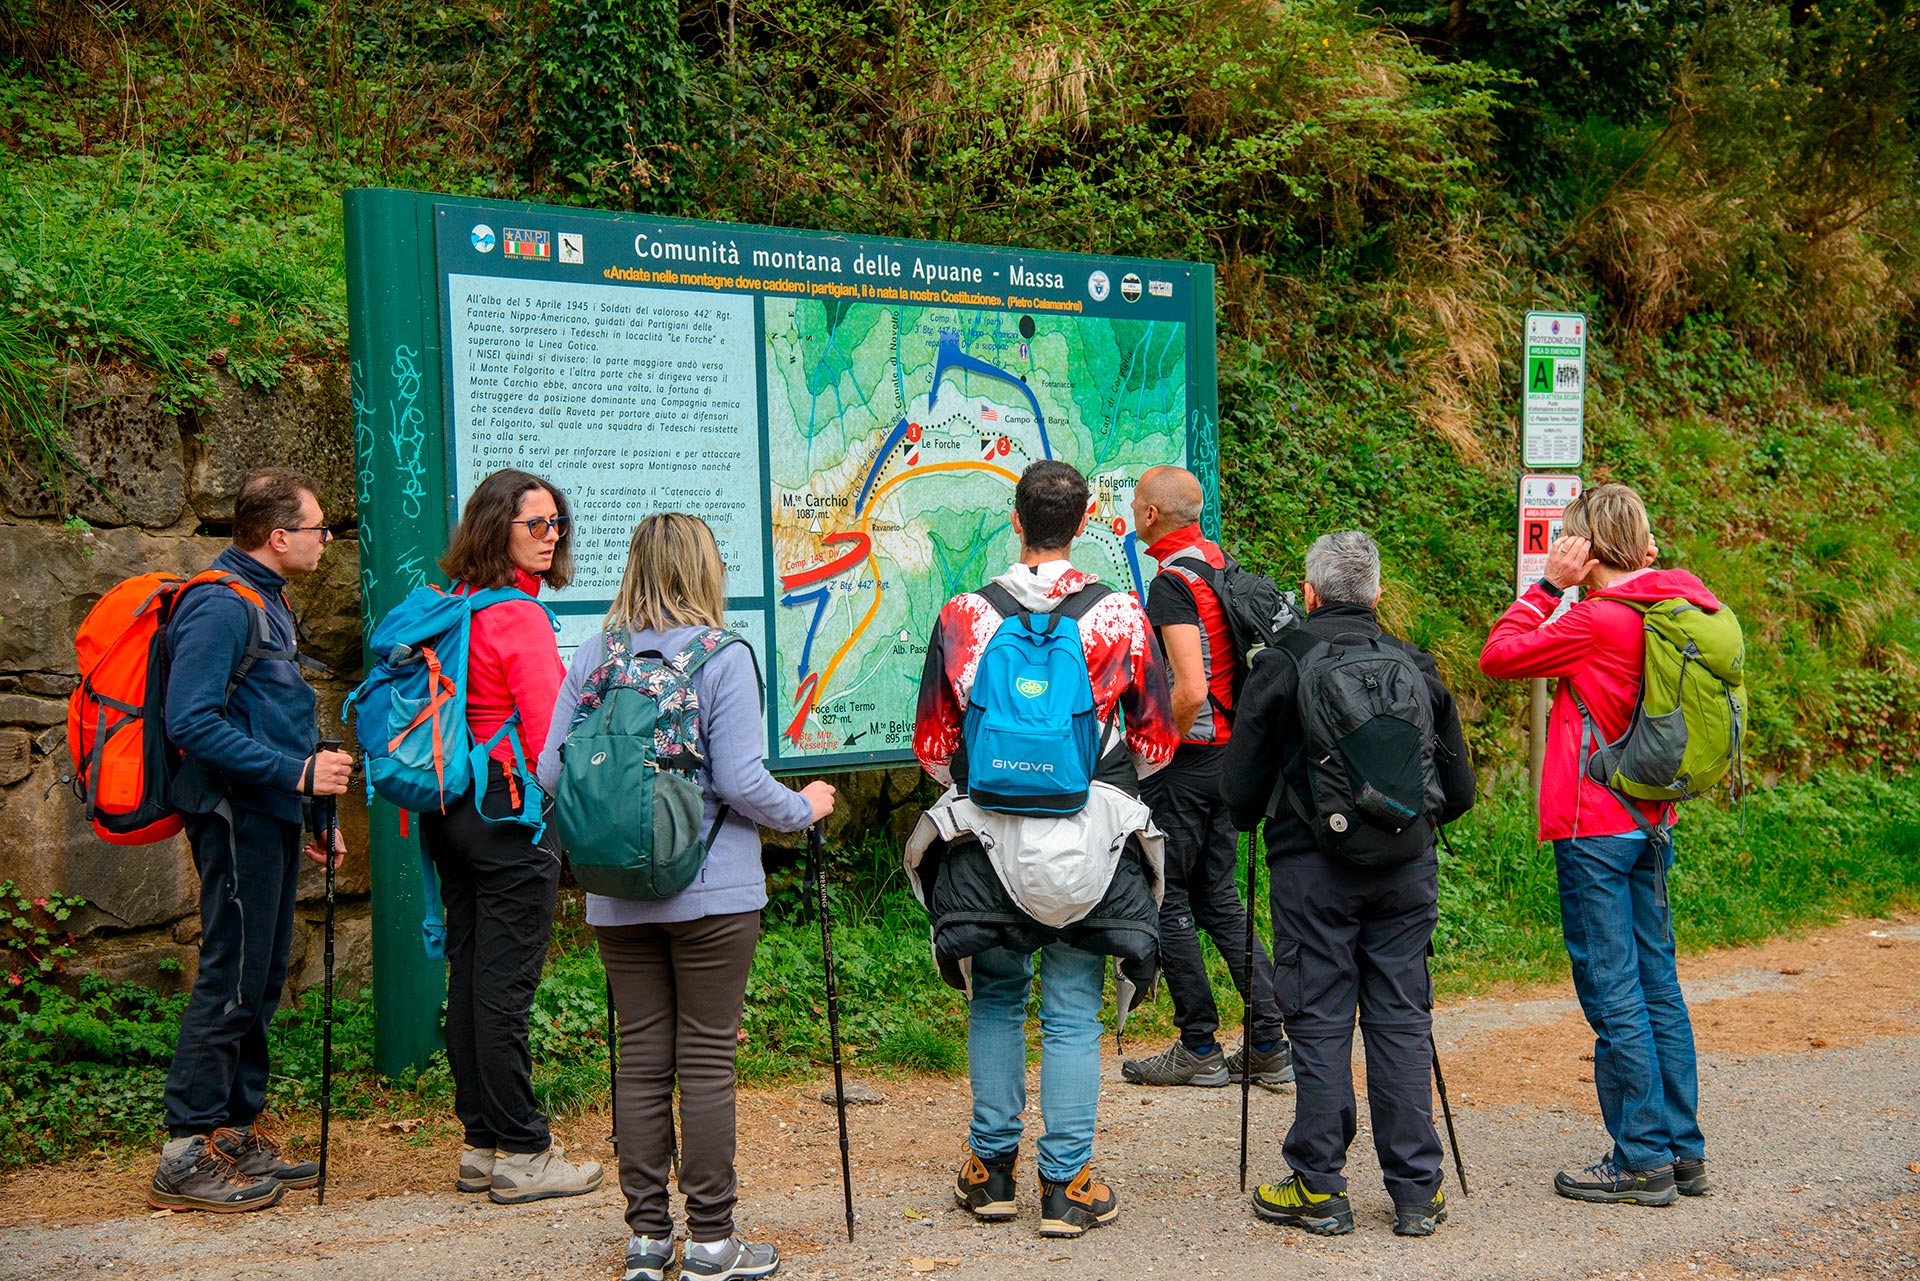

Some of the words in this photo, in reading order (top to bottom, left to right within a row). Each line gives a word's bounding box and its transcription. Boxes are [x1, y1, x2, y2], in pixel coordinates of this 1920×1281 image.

[635, 233, 740, 265] Comunità
[753, 250, 842, 272] montana
[853, 253, 901, 277] delle
[912, 257, 982, 285] Apuane
[1010, 265, 1064, 289] Massa
[603, 265, 651, 282] «Andate
[652, 270, 679, 284] nelle
[680, 272, 734, 290] montagne
[735, 275, 761, 290] dove
[762, 277, 805, 293] caddero
[806, 280, 810, 293] i
[811, 283, 860, 298] partigiani,
[869, 285, 875, 298] è
[877, 286, 898, 300] nata
[899, 287, 909, 300] la
[909, 289, 940, 302] nostra
[1033, 297, 1083, 314] Calamandrei)
[466, 295, 502, 306] All'alba
[506, 297, 520, 307] del
[535, 299, 562, 312] Aprile
[567, 300, 588, 311] 1945
[600, 302, 631, 314] Soldati
[636, 304, 649, 314] del
[653, 305, 690, 317] valoroso
[716, 309, 732, 322] Rgt.
[467, 308, 505, 320] Fanteria
[594, 315, 626, 328] guidati
[630, 317, 644, 327] dai
[648, 318, 689, 332] Partigiani
[693, 320, 712, 330] delle
[467, 322, 505, 336] Apuane,
[509, 326, 557, 338] sorpresero
[570, 327, 608, 339] Tedeschi
[613, 329, 621, 339] in
[890, 310, 899, 350] Novello
[468, 338, 520, 350] superarono
[525, 338, 534, 348] la
[539, 338, 563, 349] Linea
[567, 340, 599, 350] Gotica.
[1529, 335, 1563, 345] PROTEZIONE
[1564, 336, 1581, 345] CIVILE
[477, 349, 500, 359] NISEI
[505, 350, 534, 363] quindi
[538, 352, 546, 361] si
[593, 354, 601, 364] la
[606, 355, 629, 368] parte
[633, 356, 673, 370] maggiore
[677, 358, 698, 368] andò
[702, 362, 723, 370] verso
[890, 356, 898, 366] di
[469, 362, 476, 372] il
[480, 363, 508, 374] Monte
[513, 364, 555, 378] Folgorito
[600, 368, 624, 381] parte
[628, 369, 643, 379] che
[647, 370, 654, 380] si
[659, 370, 692, 384] dirigeva
[696, 374, 718, 382] verso
[722, 373, 728, 383] il
[1533, 361, 1549, 389] A
[470, 376, 498, 386] Monte
[503, 377, 539, 388] Carchio
[572, 382, 602, 390] ancora
[656, 383, 664, 393] la
[668, 384, 699, 397] fortuna
[703, 385, 712, 395] di
[1005, 415, 1031, 425] Campo
[1048, 417, 1069, 426] Barga
[922, 439, 932, 449] Le
[934, 439, 961, 449] Forche
[805, 494, 848, 507] Carchio
[1100, 492, 1111, 502] 911
[1524, 498, 1559, 506] PROTEZIONE
[796, 508, 815, 519] 1087
[872, 524, 901, 532] Ravaneto
[1529, 523, 1543, 551] R
[893, 645, 907, 655] Alb.
[811, 704, 830, 714] Foce
[834, 703, 846, 713] del
[850, 702, 875, 712] Termo
[822, 714, 837, 725] 827
[889, 720, 915, 733] Belve
[885, 733, 900, 743] 895
[992, 758, 1054, 773] GIVOVA
[818, 871, 827, 909] TREKKING
